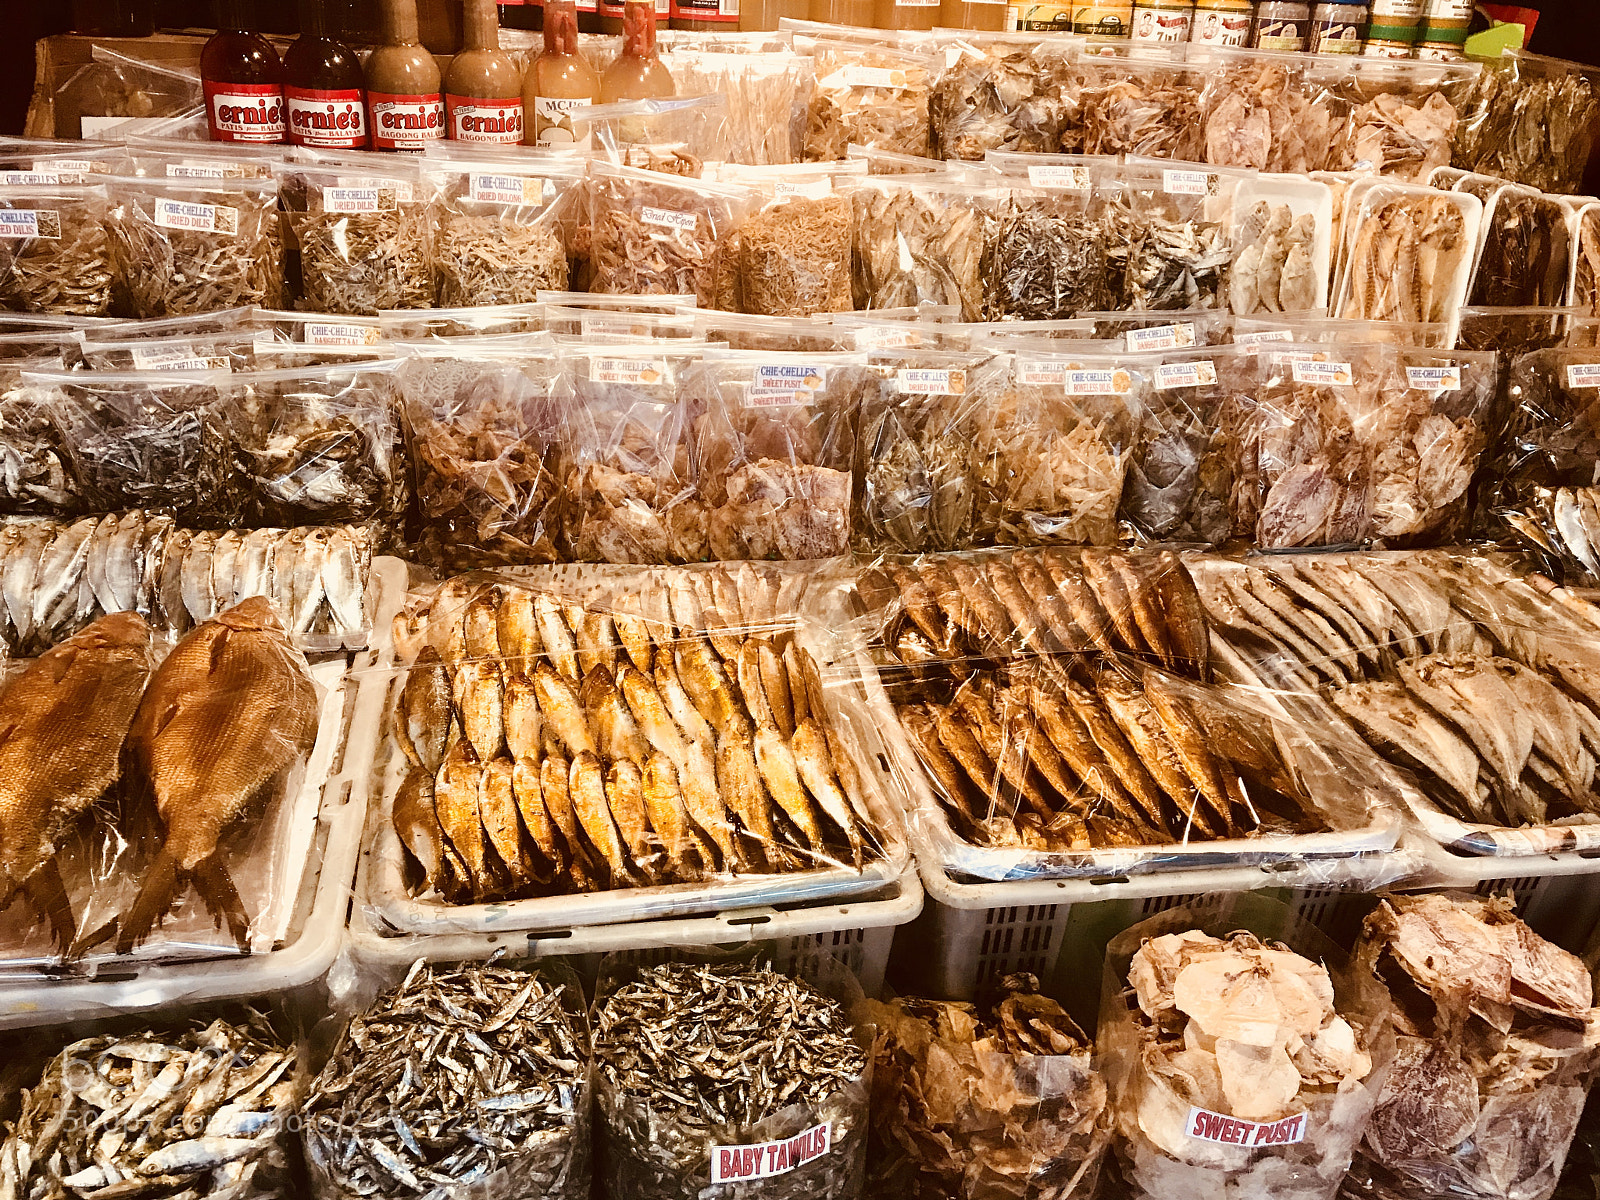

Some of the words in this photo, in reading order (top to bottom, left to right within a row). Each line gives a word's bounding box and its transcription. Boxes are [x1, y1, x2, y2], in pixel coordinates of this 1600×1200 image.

[292, 104, 361, 130] ernie's
[381, 104, 444, 129] ernie's
[462, 108, 521, 133] ernie's
[478, 176, 523, 192] CHIE-CHELLE'S
[331, 189, 377, 201] CHIE-CHELLE'S
[477, 191, 497, 201] DRIED
[497, 193, 522, 203] DULONG
[164, 202, 214, 219] CHIE-CHELLE'S
[334, 201, 356, 210] DRIED
[357, 201, 375, 210] DILIS
[167, 214, 190, 227] DRIED
[191, 217, 211, 229] DILIS
[311, 326, 364, 338] CHIE-CHELLE'S
[760, 366, 816, 377] CHIE-CHELLE'S
[1297, 362, 1344, 373] CHIE-CHELLE'S
[599, 372, 619, 381] SWEET
[1072, 373, 1112, 382] CHIE-CHELLE'S
[763, 378, 783, 388] SWEET
[784, 379, 802, 389] PUSIT
[909, 383, 928, 391] DRIED
[1193, 1111, 1255, 1145] SWEET
[1253, 1115, 1303, 1146] PUSIT
[720, 1147, 764, 1179] BABY
[767, 1125, 827, 1173] TAWILIS
